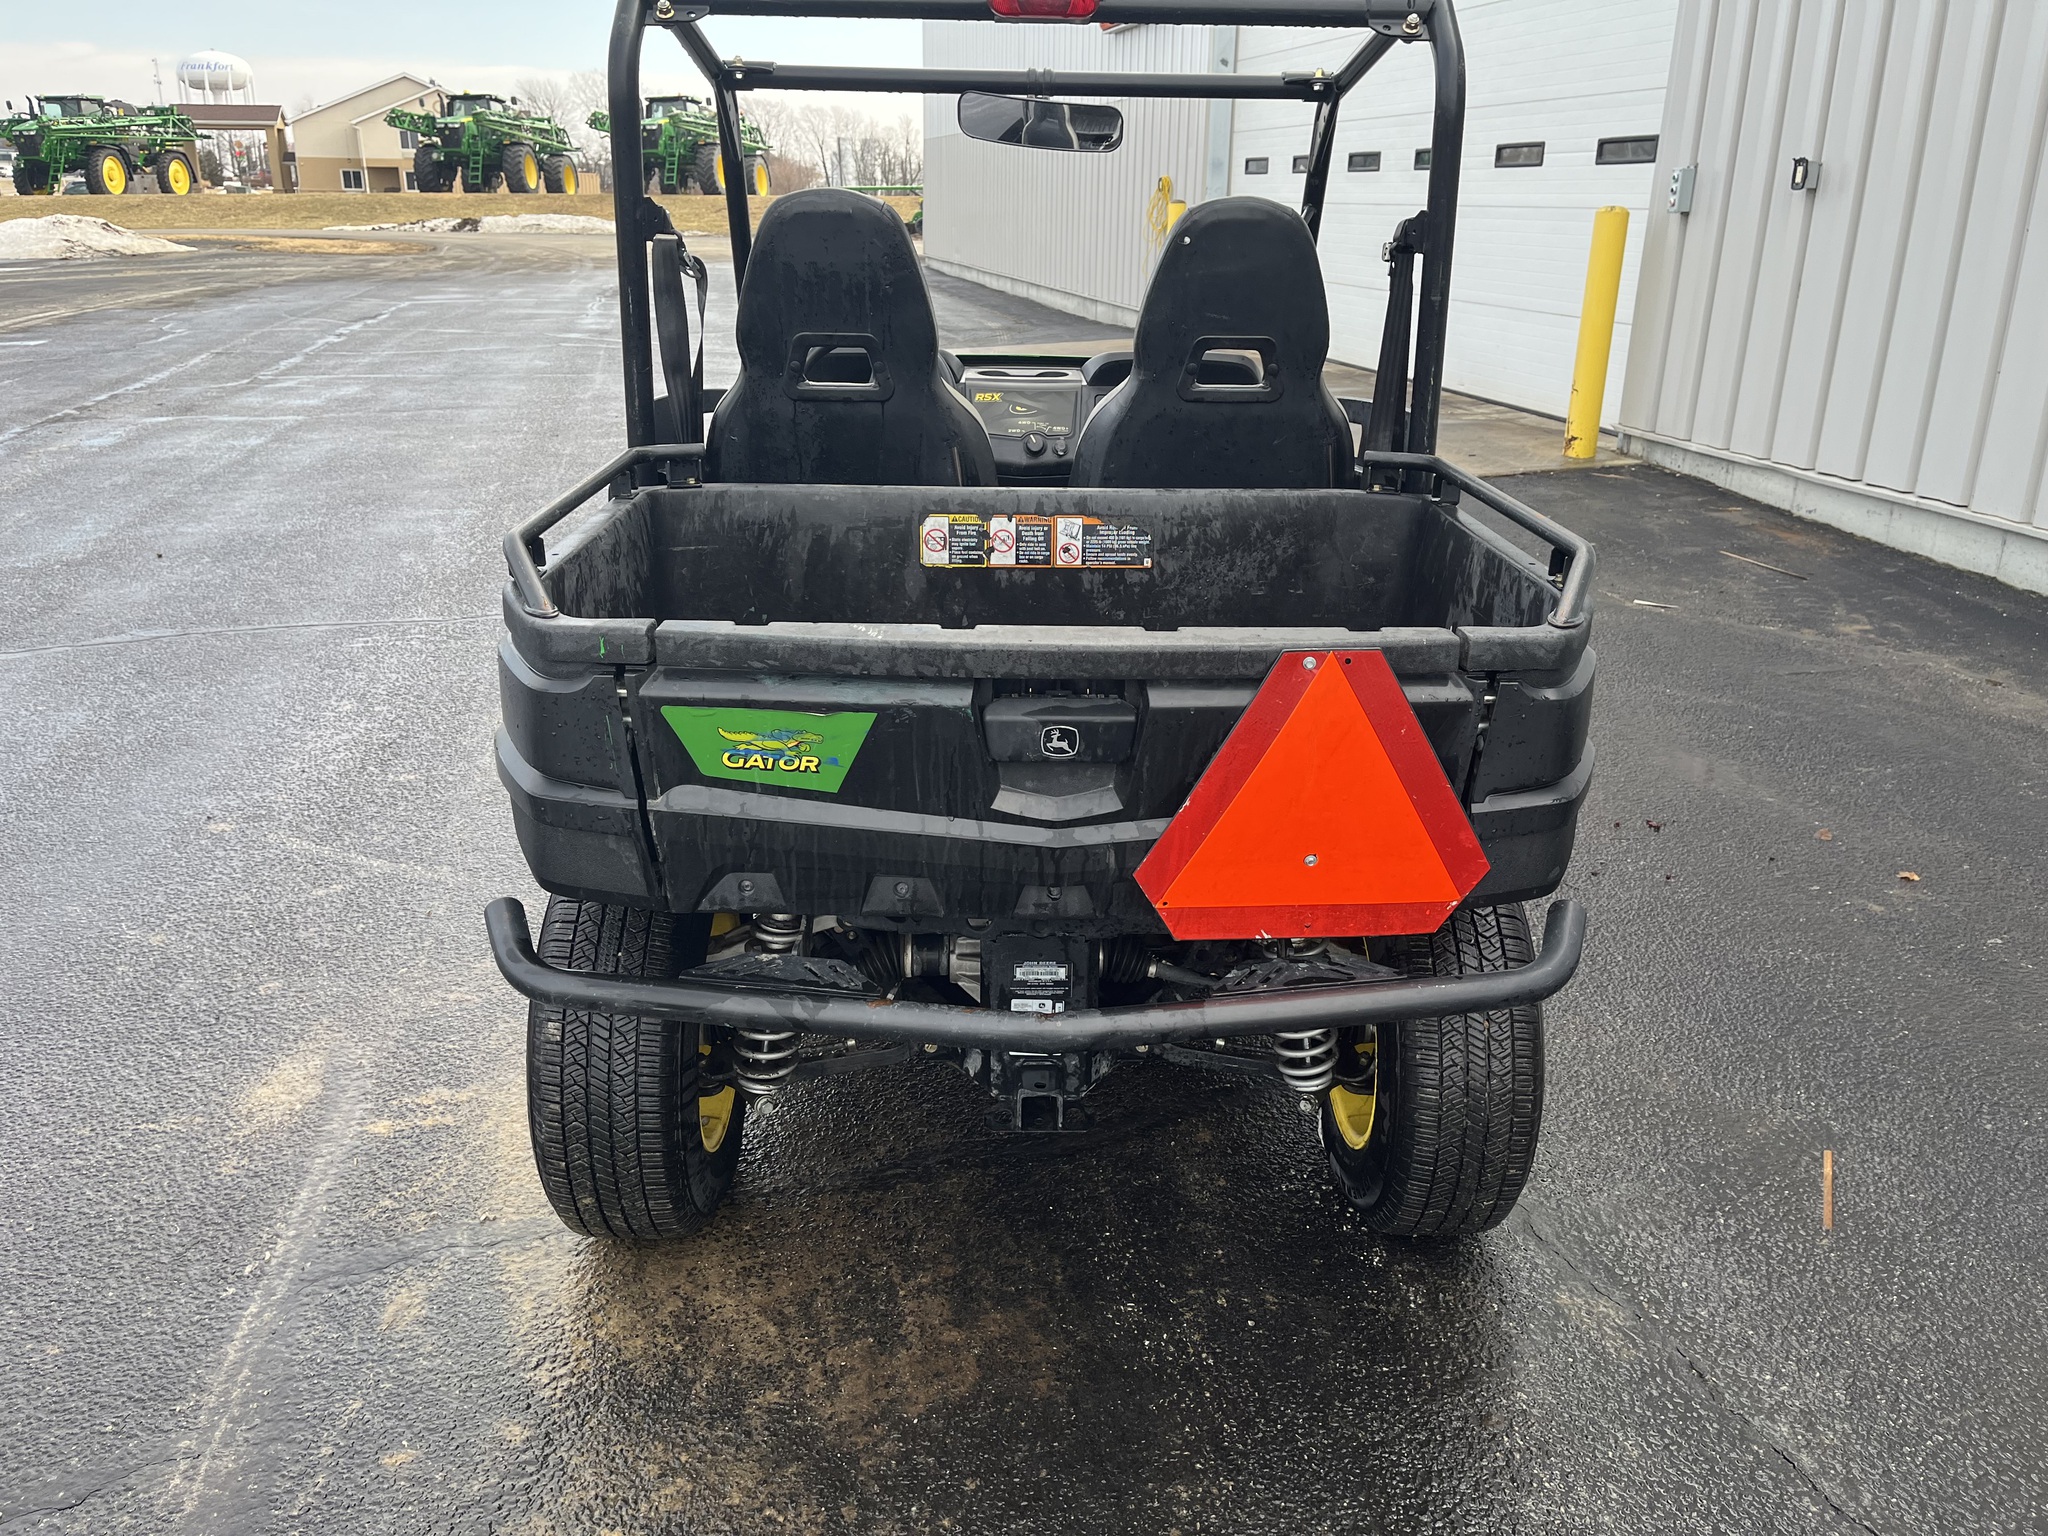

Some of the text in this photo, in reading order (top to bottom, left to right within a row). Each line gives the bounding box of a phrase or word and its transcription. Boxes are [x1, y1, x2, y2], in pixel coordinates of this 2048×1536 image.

[181, 61, 233, 72] Frankfort
[975, 393, 1003, 402] RSX
[722, 751, 821, 773] GATOR
